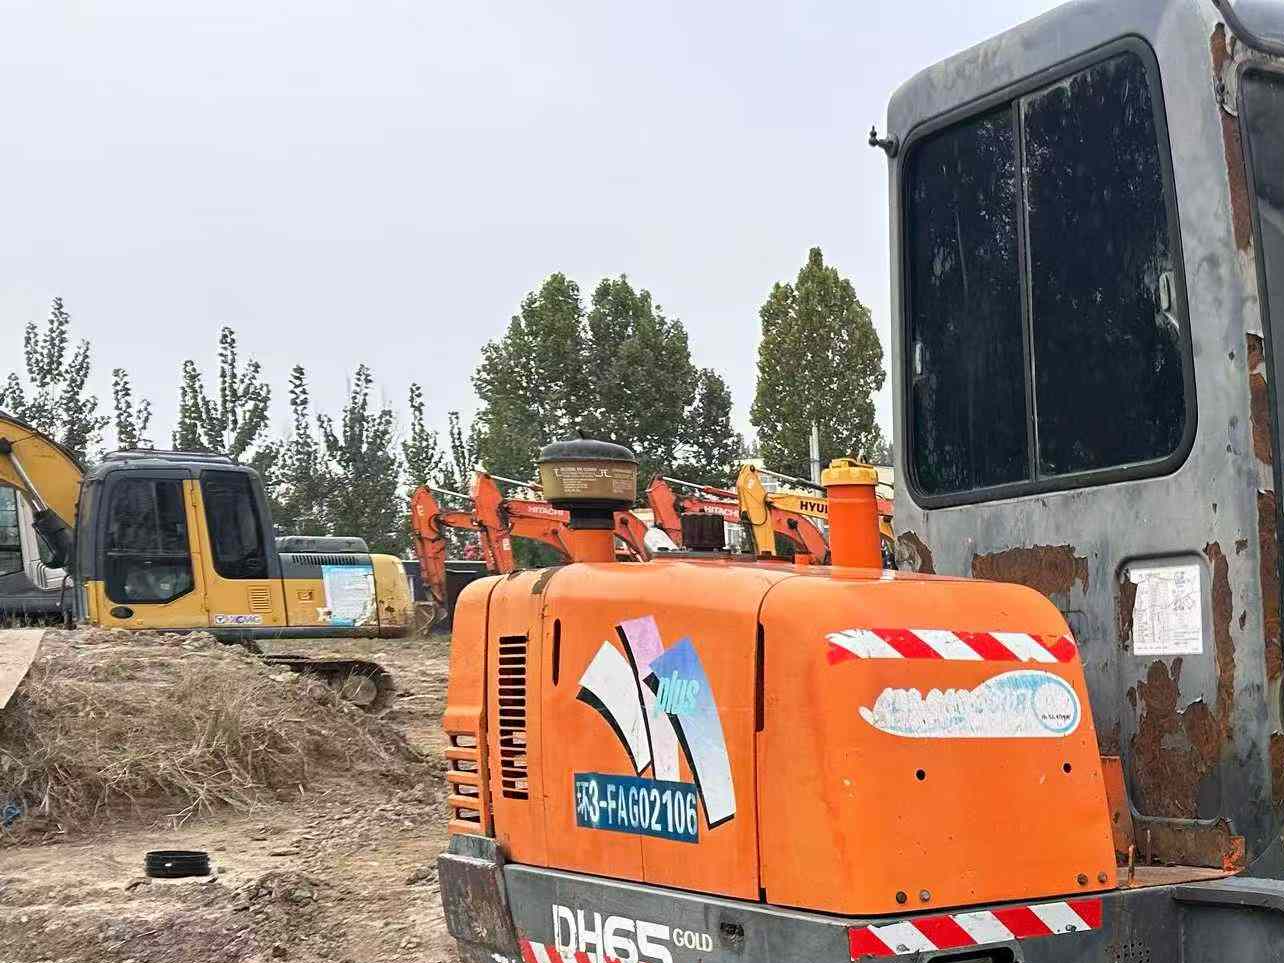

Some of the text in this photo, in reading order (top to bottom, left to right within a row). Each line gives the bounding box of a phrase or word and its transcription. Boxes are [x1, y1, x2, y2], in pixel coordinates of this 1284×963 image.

[528, 506, 564, 516] HITACHI
[656, 671, 700, 717] plus
[672, 928, 714, 952] GOLD
